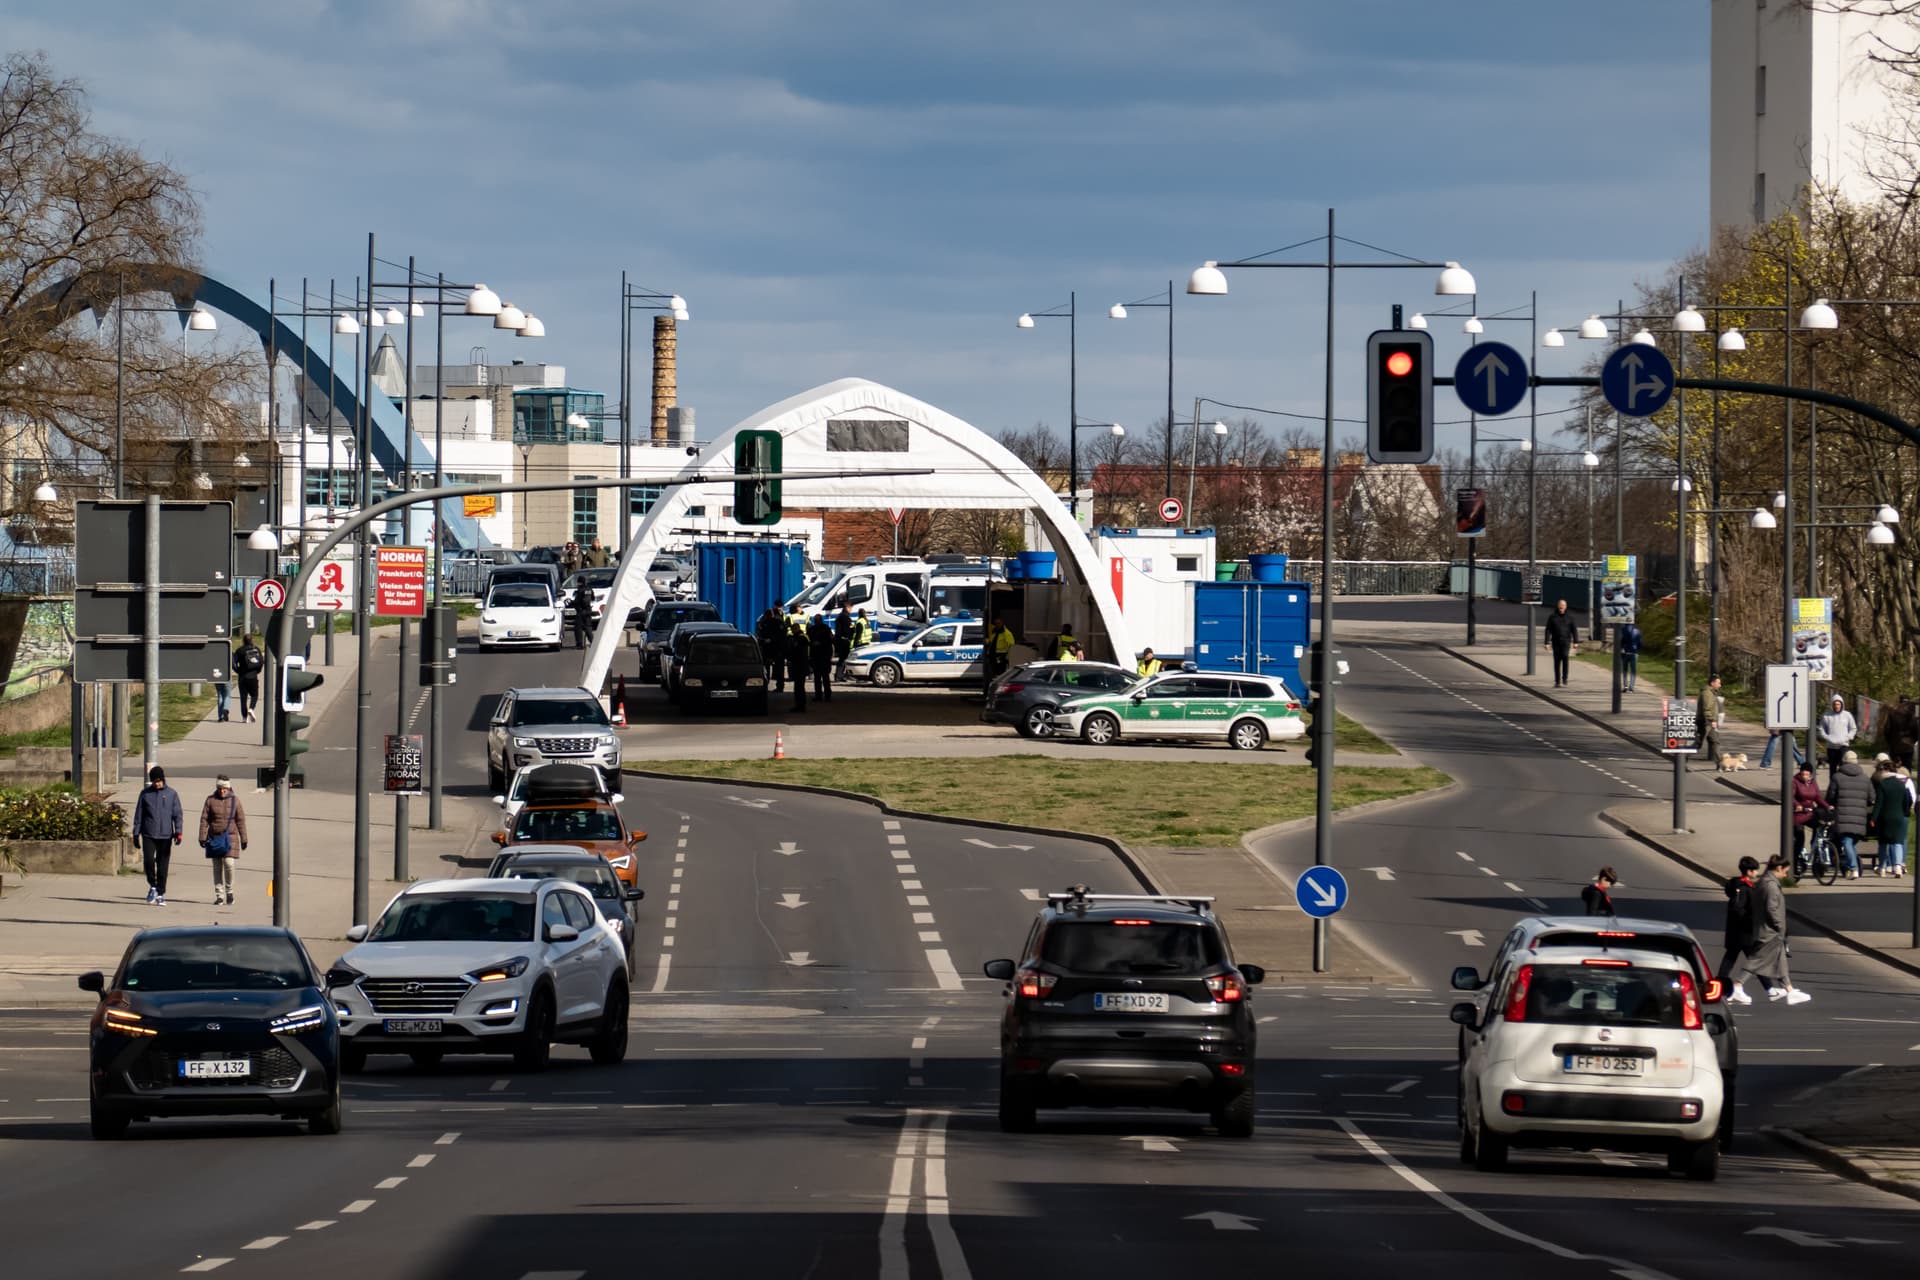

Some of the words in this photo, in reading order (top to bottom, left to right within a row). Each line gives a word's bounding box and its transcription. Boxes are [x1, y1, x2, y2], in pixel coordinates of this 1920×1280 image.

[380, 552, 424, 562] NORMA
[384, 590, 395, 598] für
[1668, 716, 1697, 726] HEISE
[389, 753, 421, 765] HEISE
[1106, 995, 1122, 1007] FF
[1130, 996, 1146, 1008] XD
[1148, 996, 1163, 1008] 92
[389, 1021, 407, 1031] SEE
[428, 1021, 441, 1031] 61
[190, 1062, 205, 1074] FF
[213, 1062, 221, 1074] X
[223, 1062, 245, 1074] 132
[1576, 1056, 1593, 1068] FF
[1613, 1058, 1637, 1070] 253
